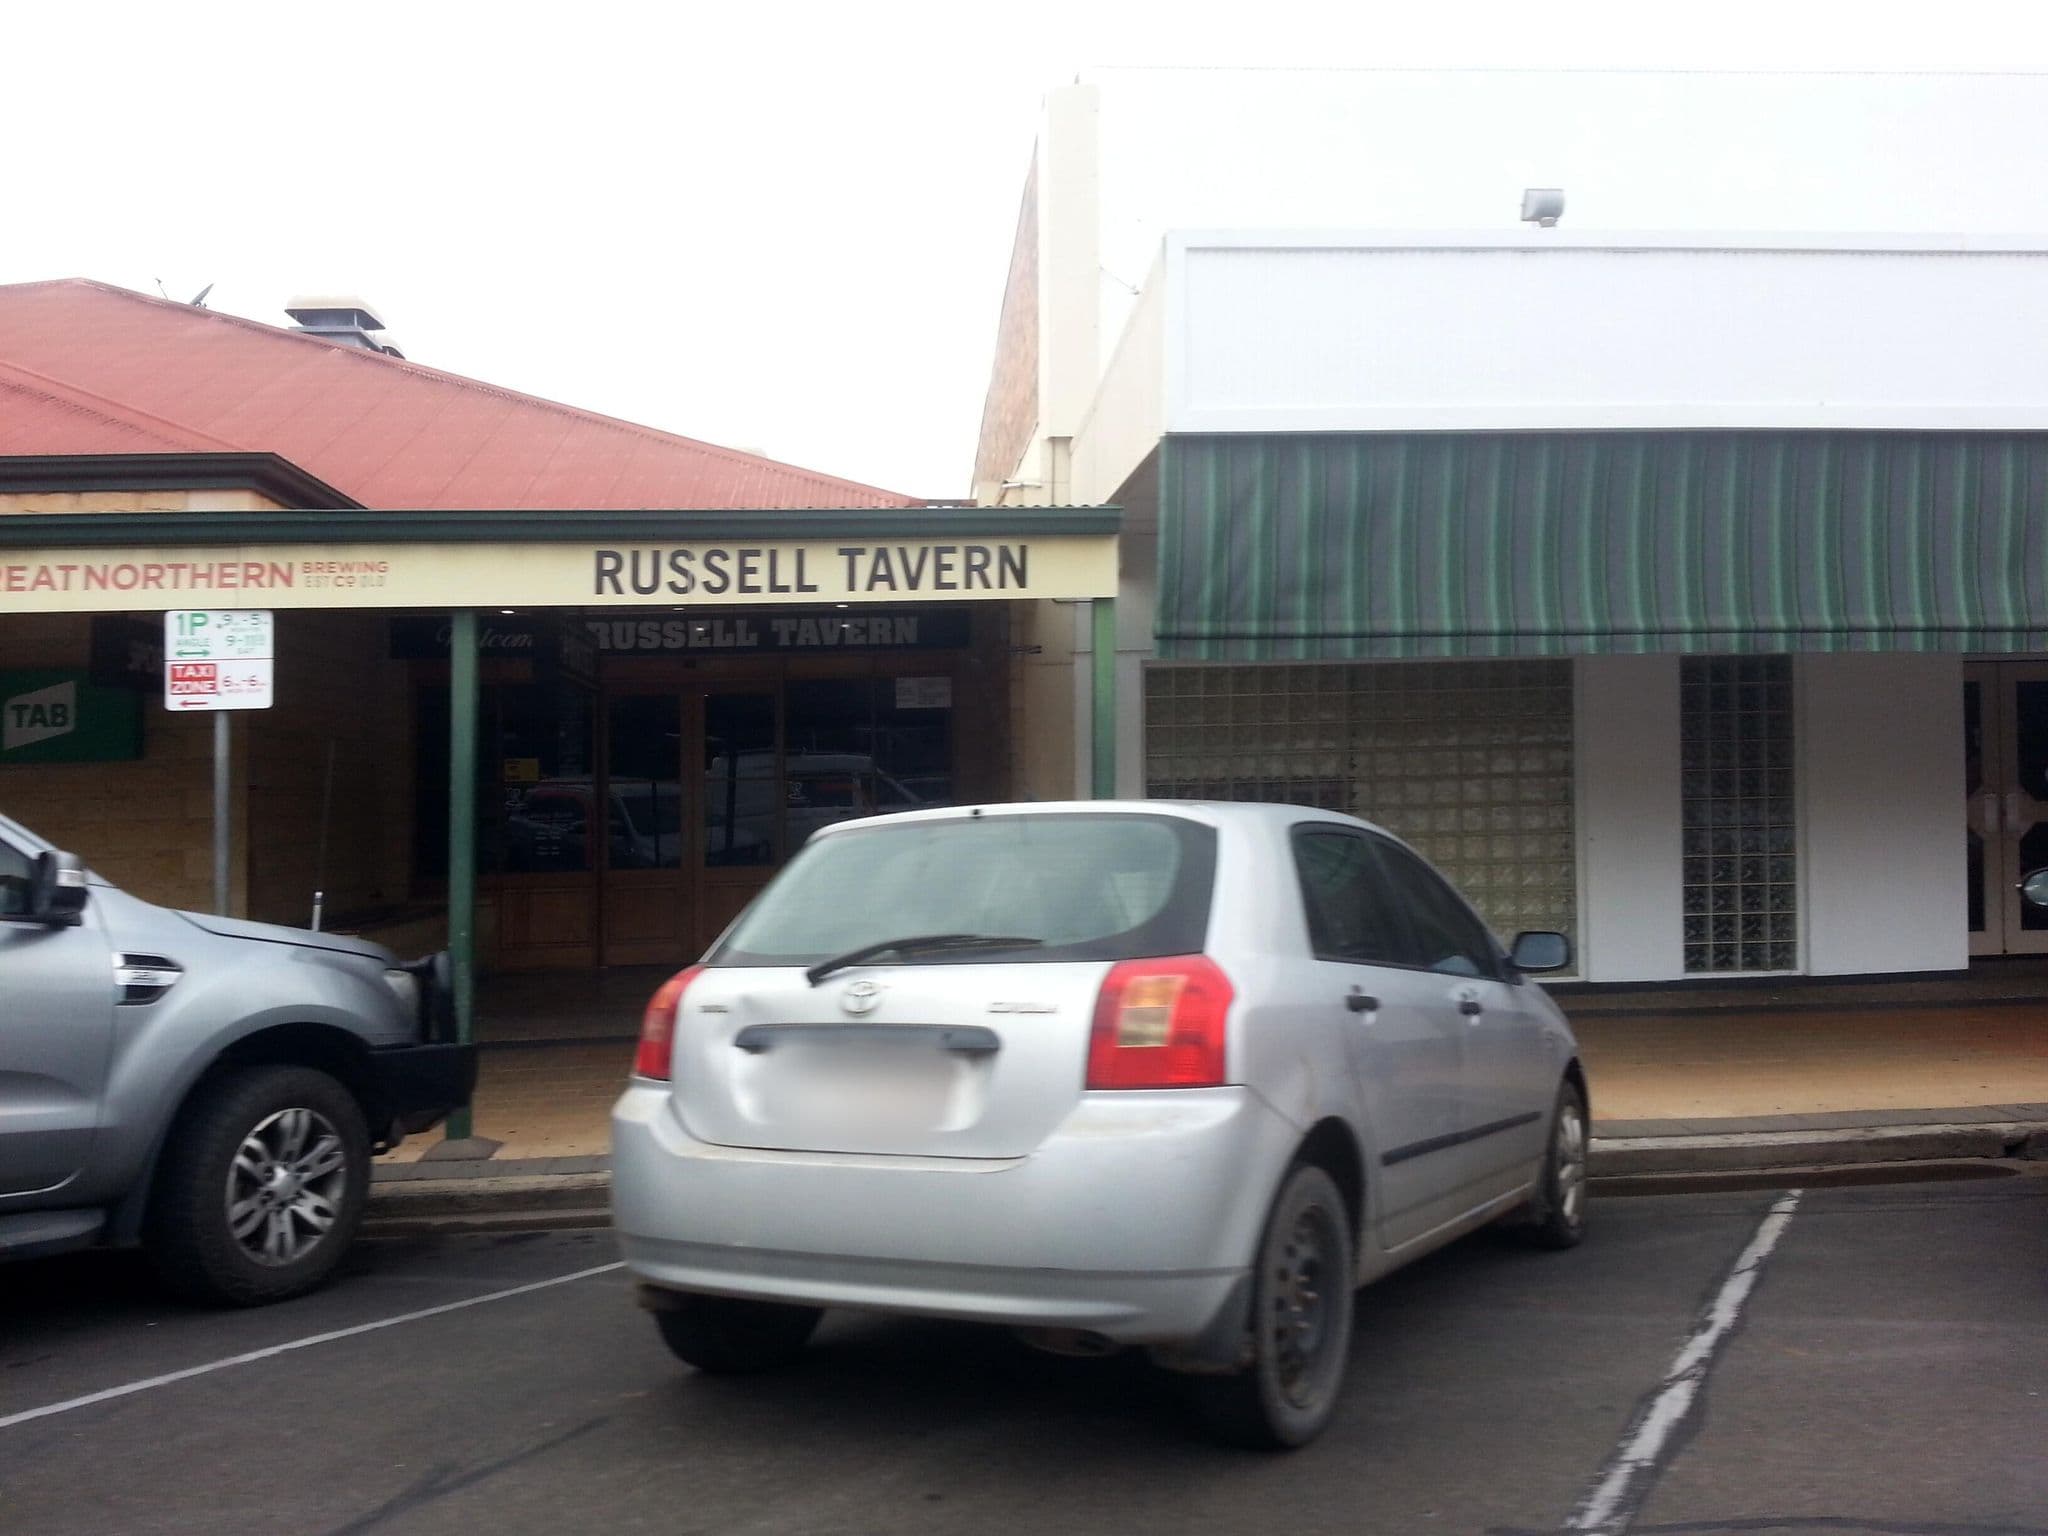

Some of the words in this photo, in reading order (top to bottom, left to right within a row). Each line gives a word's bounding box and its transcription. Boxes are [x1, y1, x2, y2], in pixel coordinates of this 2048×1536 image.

[83, 561, 294, 590] NORTHERN
[302, 560, 389, 574] BREWING
[594, 548, 819, 595] RUSSELL
[837, 544, 1028, 592] TAVERN
[176, 612, 208, 635] 1P
[585, 619, 758, 650] RUSSELL
[771, 617, 918, 646] TAVERN
[172, 666, 215, 678] TAXI
[171, 682, 215, 694] ZONE
[10, 703, 69, 728] TAB
